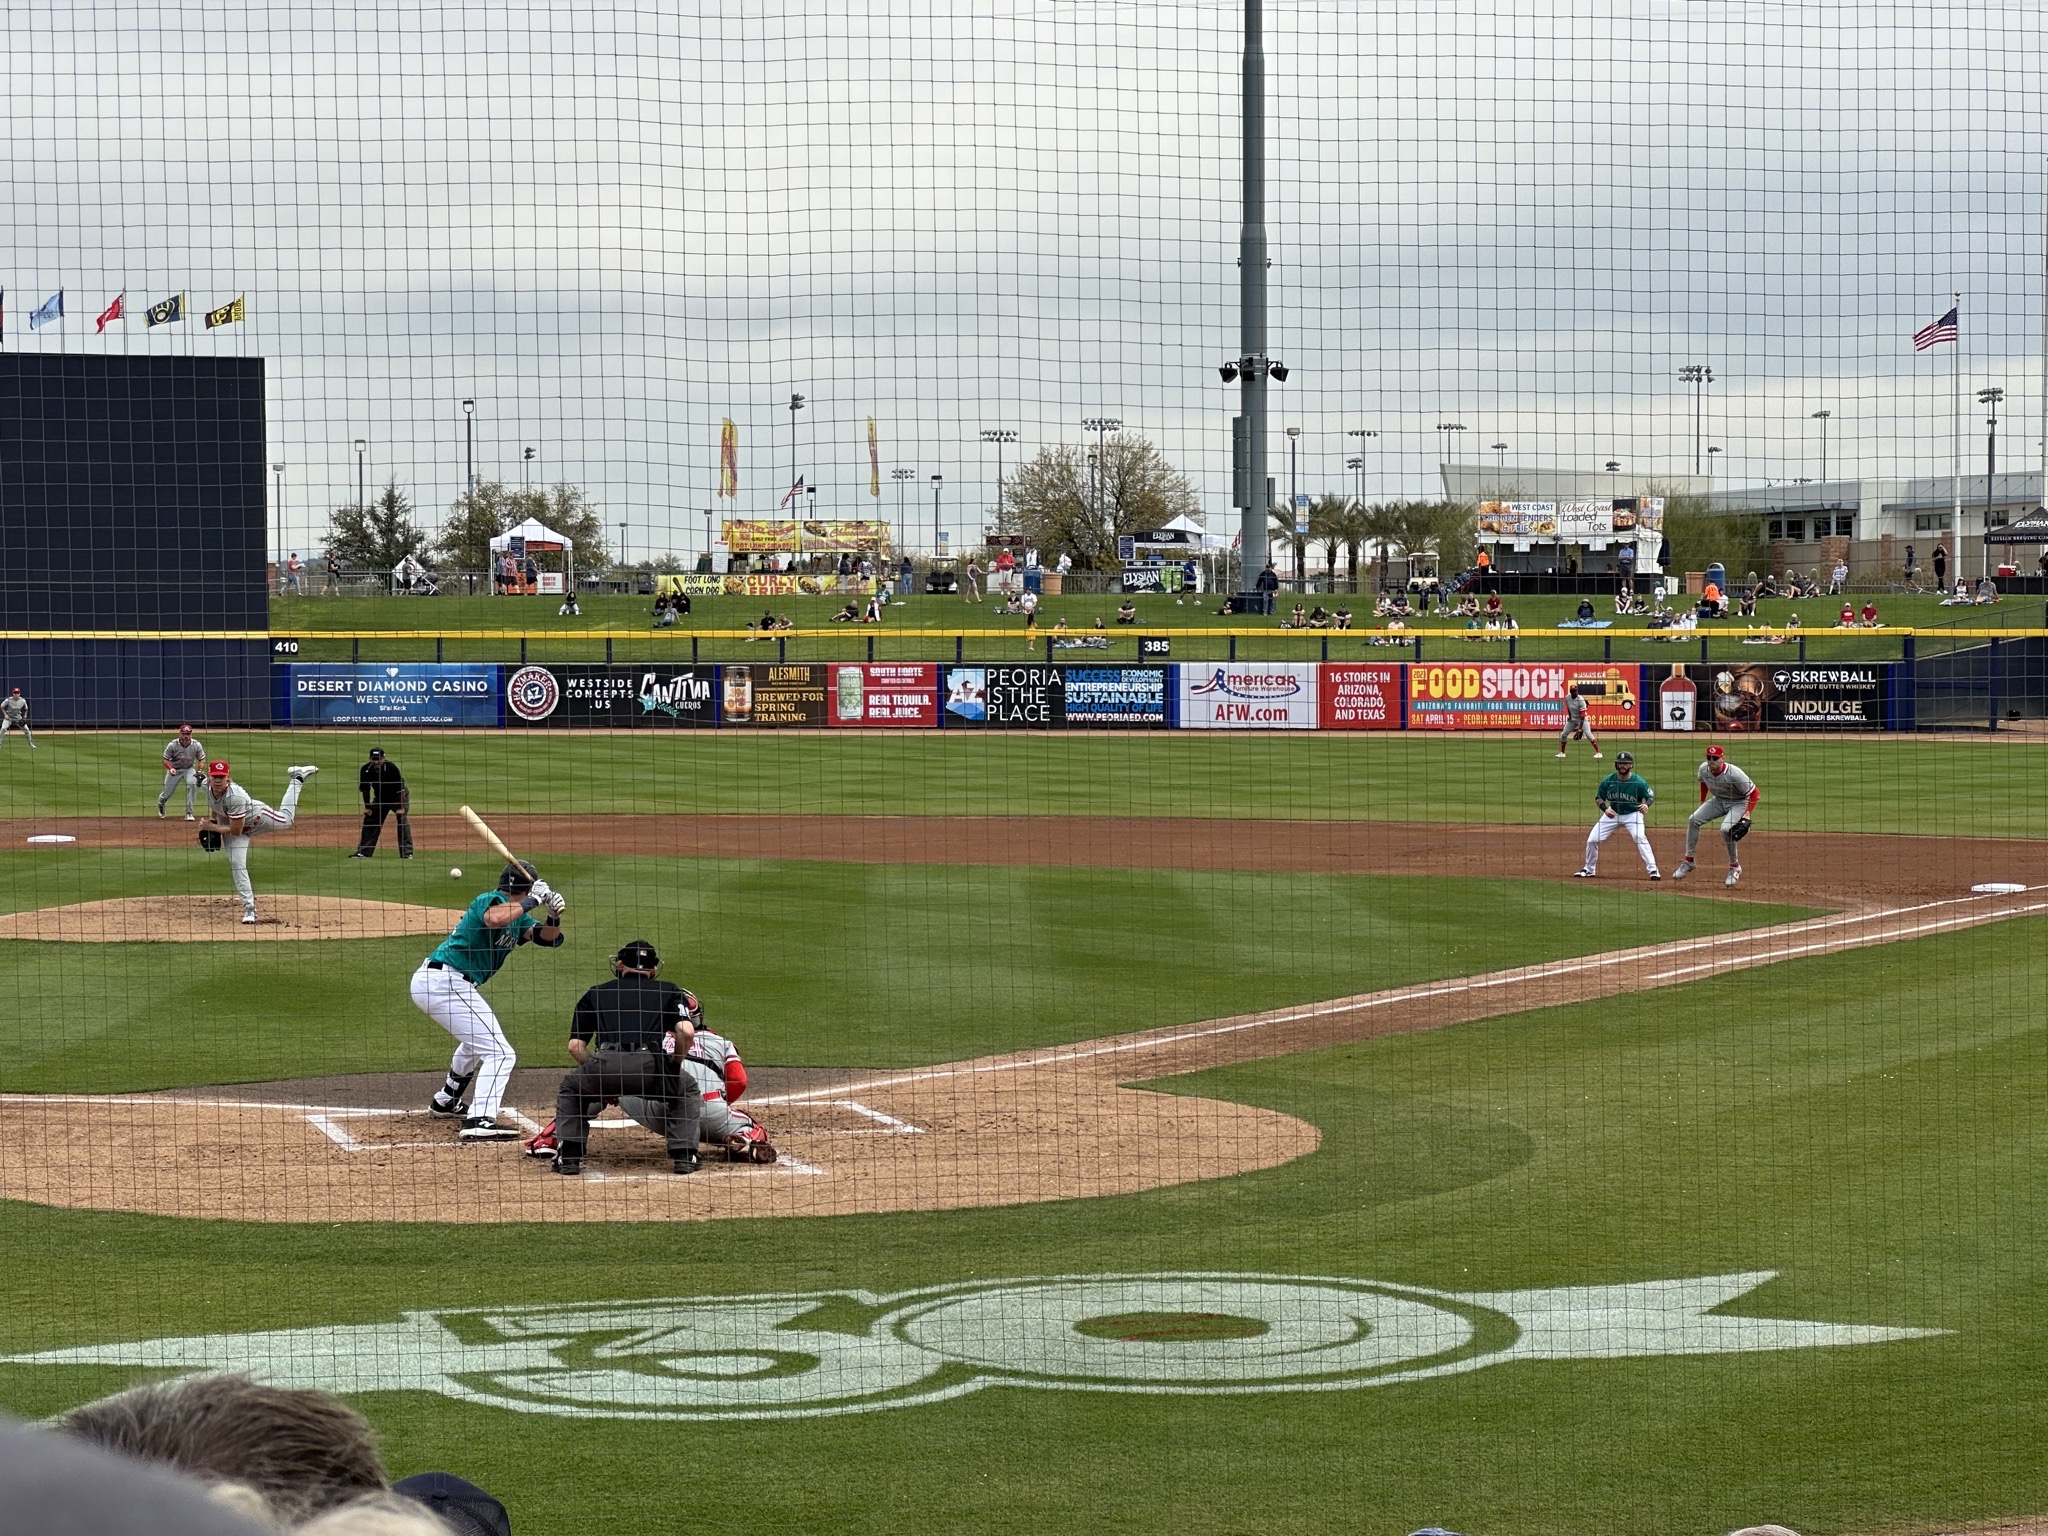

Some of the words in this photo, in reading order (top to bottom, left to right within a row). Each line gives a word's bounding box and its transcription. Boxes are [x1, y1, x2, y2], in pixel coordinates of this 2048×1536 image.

[1562, 503, 1585, 512] West
[1586, 502, 1613, 512] Coast
[1562, 512, 1597, 522] Loaded
[1511, 524, 1533, 532] FRIES
[1587, 522, 1607, 531] Tots
[684, 575, 702, 584] FOOT
[703, 575, 720, 584] LONG
[746, 575, 795, 586] CURLY
[1123, 570, 1160, 586] ELYSIAN
[685, 587, 704, 595] CORN
[705, 587, 720, 595] DOG
[749, 587, 795, 595] FRIES
[274, 642, 298, 653] 410
[1144, 640, 1170, 652] 385
[768, 666, 810, 681] ALESMITH
[869, 667, 896, 676] SOUTH
[987, 668, 1062, 686] PEORIA
[1065, 669, 1120, 682] SUCCESS
[1121, 669, 1164, 677] ECONOMIC
[1791, 670, 1877, 682] SKREWBALL
[1329, 672, 1342, 683] 16
[1343, 672, 1378, 683] STORES
[1380, 672, 1391, 683] IN
[297, 681, 354, 692] DESERT
[358, 681, 427, 692] DIAMOND
[432, 681, 488, 692] CASINO
[512, 672, 552, 701] HAYMAKER
[567, 679, 633, 688] WESTSIDE
[1065, 682, 1164, 692] ENTREPRENEURSHIP
[527, 686, 543, 702] AZ
[566, 689, 634, 698] CONCEPTS
[987, 687, 1003, 704] IS
[1007, 687, 1046, 704] THE
[1337, 684, 1383, 697] ARIZONA,
[356, 695, 385, 704] WEST
[389, 695, 430, 704] VALLEY
[754, 693, 800, 701] BREWED
[802, 693, 824, 701] FOR
[869, 694, 891, 705] REAL
[892, 694, 932, 706] TEQUILA.
[1065, 692, 1164, 703] SUSTAINABLE
[589, 700, 611, 709] .US
[754, 703, 795, 712] SPRING
[1065, 703, 1089, 712] HIGH
[1090, 703, 1130, 713] QUALITY
[1131, 703, 1144, 712] OF
[1145, 703, 1163, 712] LIFE
[1334, 697, 1386, 709] COLORADO,
[1417, 702, 1452, 710] ARIZONA'S
[1454, 702, 1483, 710] FAVORITE
[1487, 702, 1503, 710] FOOD
[1506, 702, 1527, 710] TRUCK
[1529, 702, 1559, 710] FESTIVAL
[1788, 700, 1863, 714] INDULGE
[754, 713, 807, 721] TRAINING
[869, 707, 891, 718] REAL
[892, 707, 922, 718] JUICE.
[987, 704, 1051, 721] PLACE
[1065, 712, 1164, 722] WWW.PEORIAED.COM
[1215, 704, 1288, 720] AFW.com
[1335, 709, 1355, 720] AND
[1357, 709, 1386, 720] TEXAS
[1411, 714, 1424, 725] SAT
[1425, 714, 1445, 725] APRIL
[1447, 714, 1454, 725] 15
[1463, 714, 1488, 725] PEORIA
[1490, 714, 1521, 725] STADIUM
[1530, 714, 1545, 725] LIVE
[1547, 714, 1569, 725] MUSIC
[1598, 715, 1636, 725] ACTIVITIES
